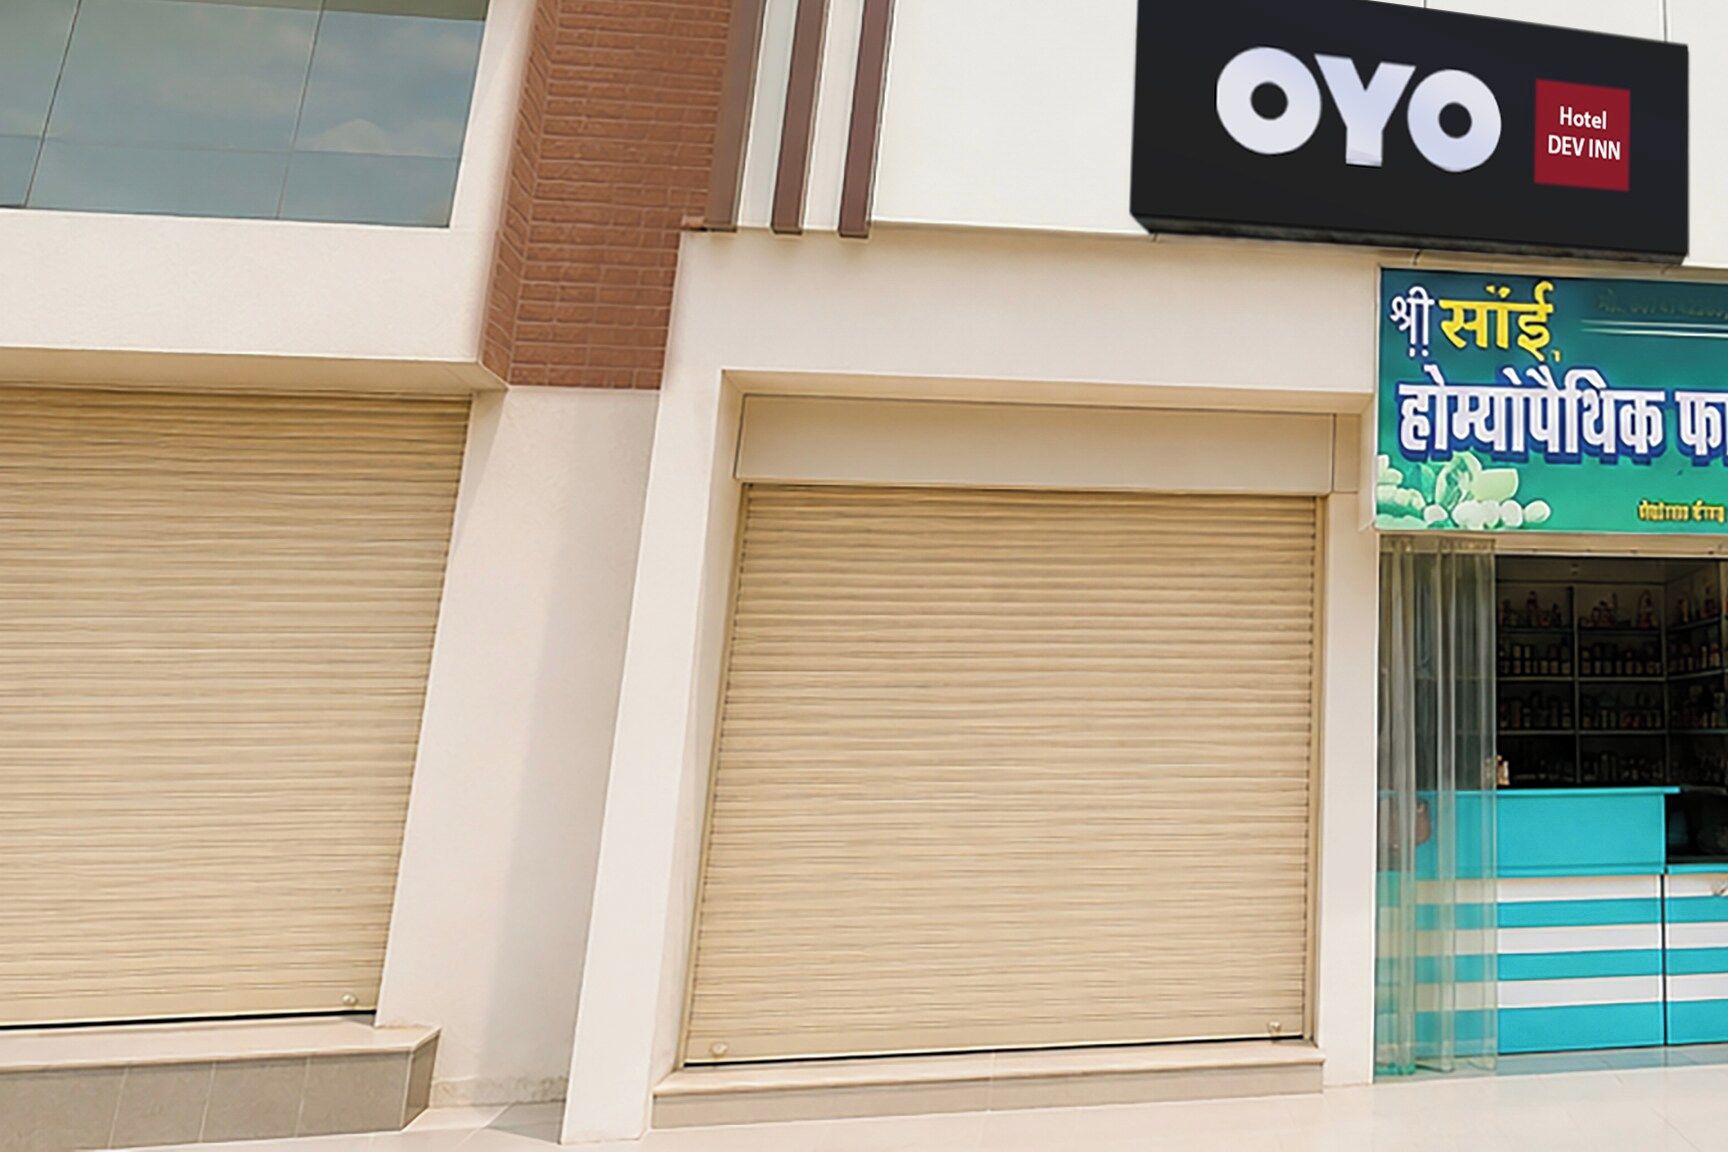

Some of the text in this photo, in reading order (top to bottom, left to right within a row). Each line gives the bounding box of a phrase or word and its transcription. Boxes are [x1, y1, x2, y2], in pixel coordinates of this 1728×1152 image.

[1216, 46, 1502, 172] OYO
[1559, 105, 1607, 131] Hotel
[1547, 134, 1621, 161] DEV INN
[1390, 286, 1435, 357] श्री
